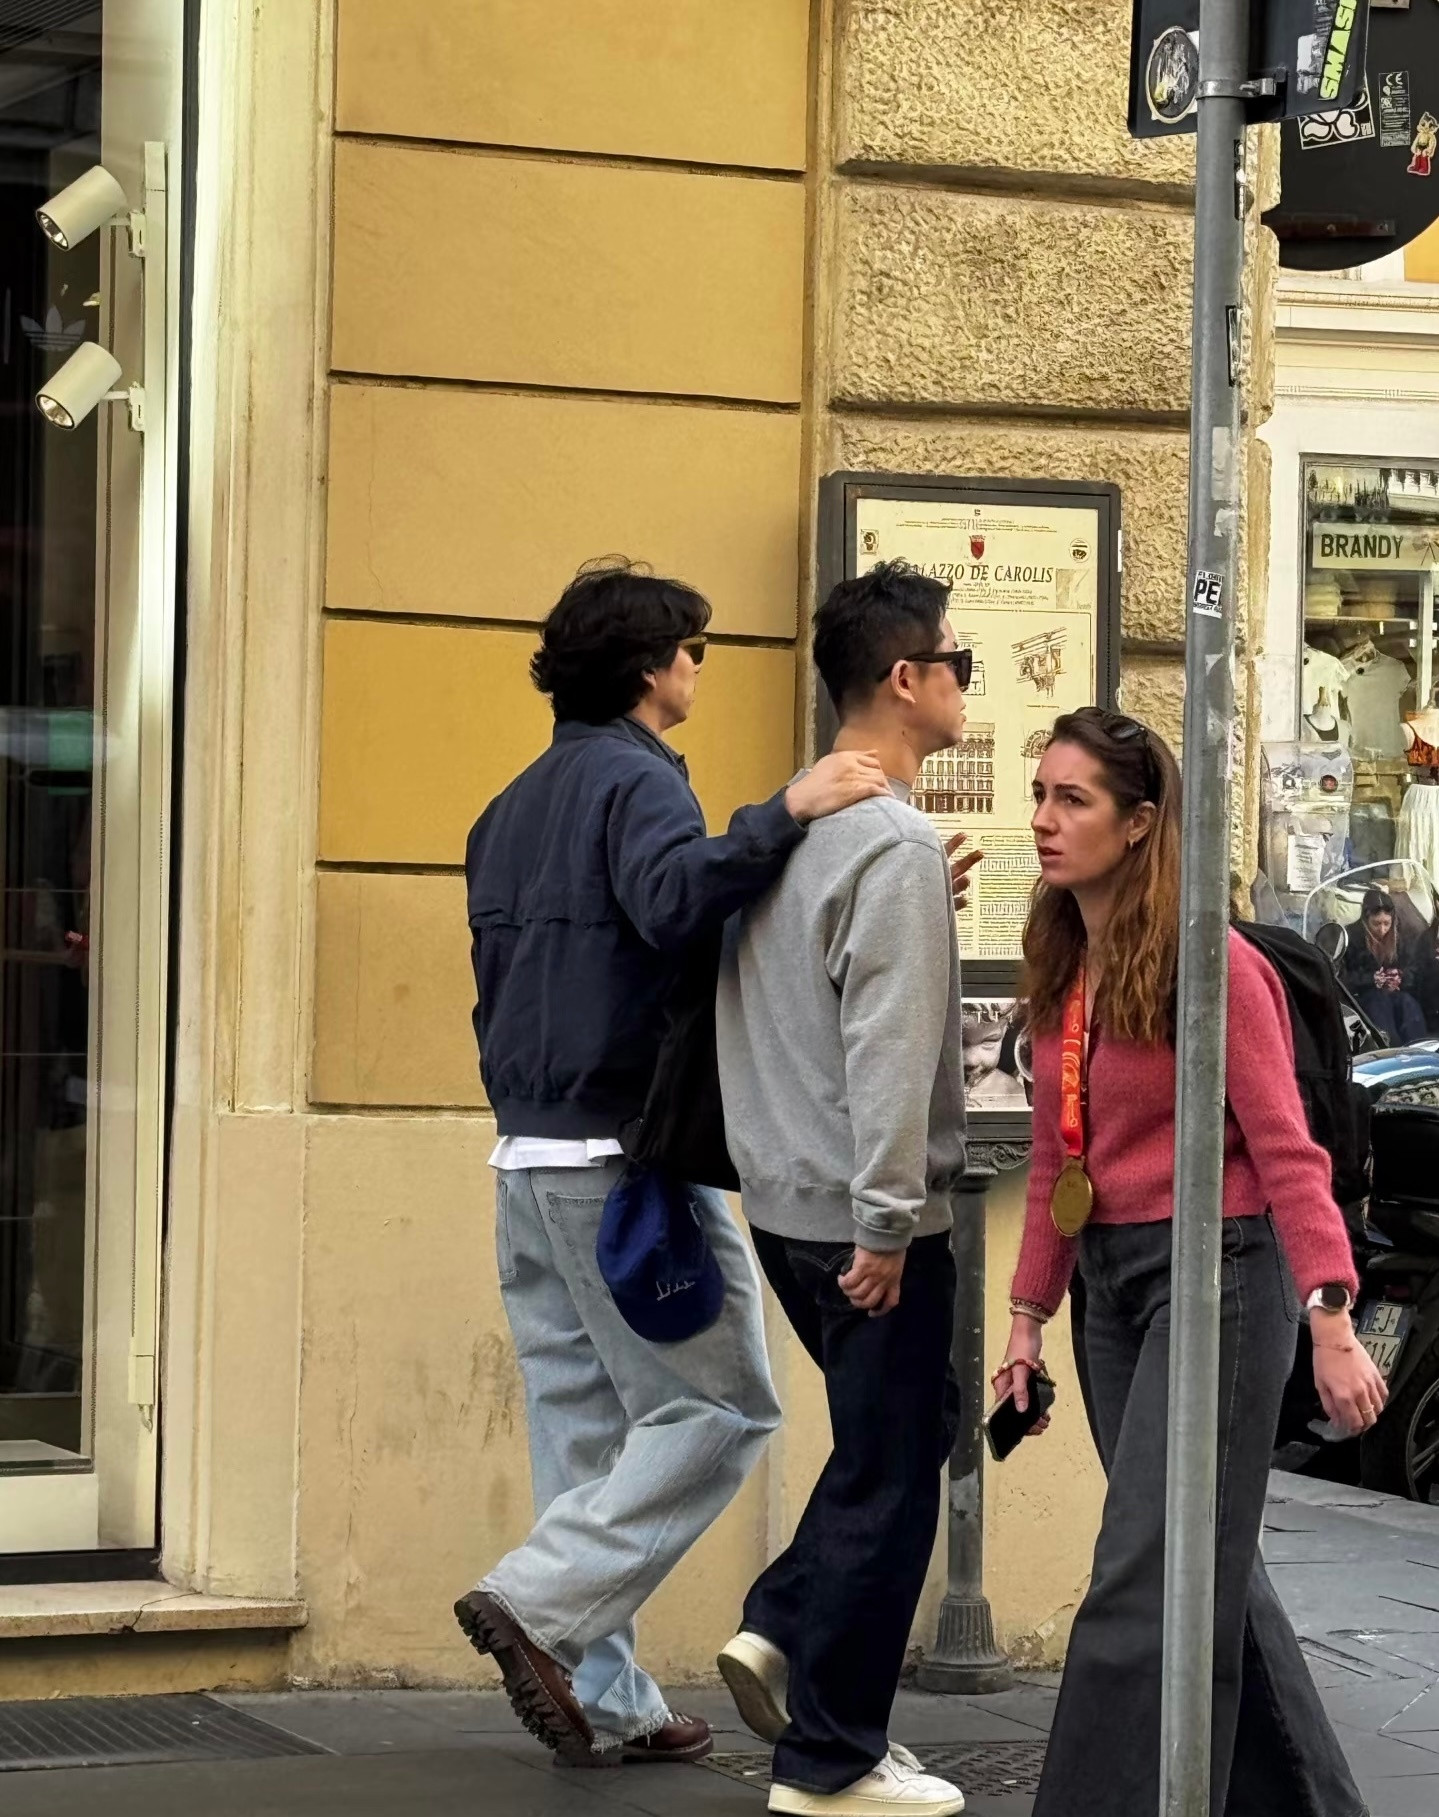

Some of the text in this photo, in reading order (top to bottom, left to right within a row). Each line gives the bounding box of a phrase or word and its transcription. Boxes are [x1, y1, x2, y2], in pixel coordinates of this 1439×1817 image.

[1321, 534, 1404, 559] BRANDY
[970, 564, 990, 581] DE
[995, 566, 1054, 583] CAROLIS
